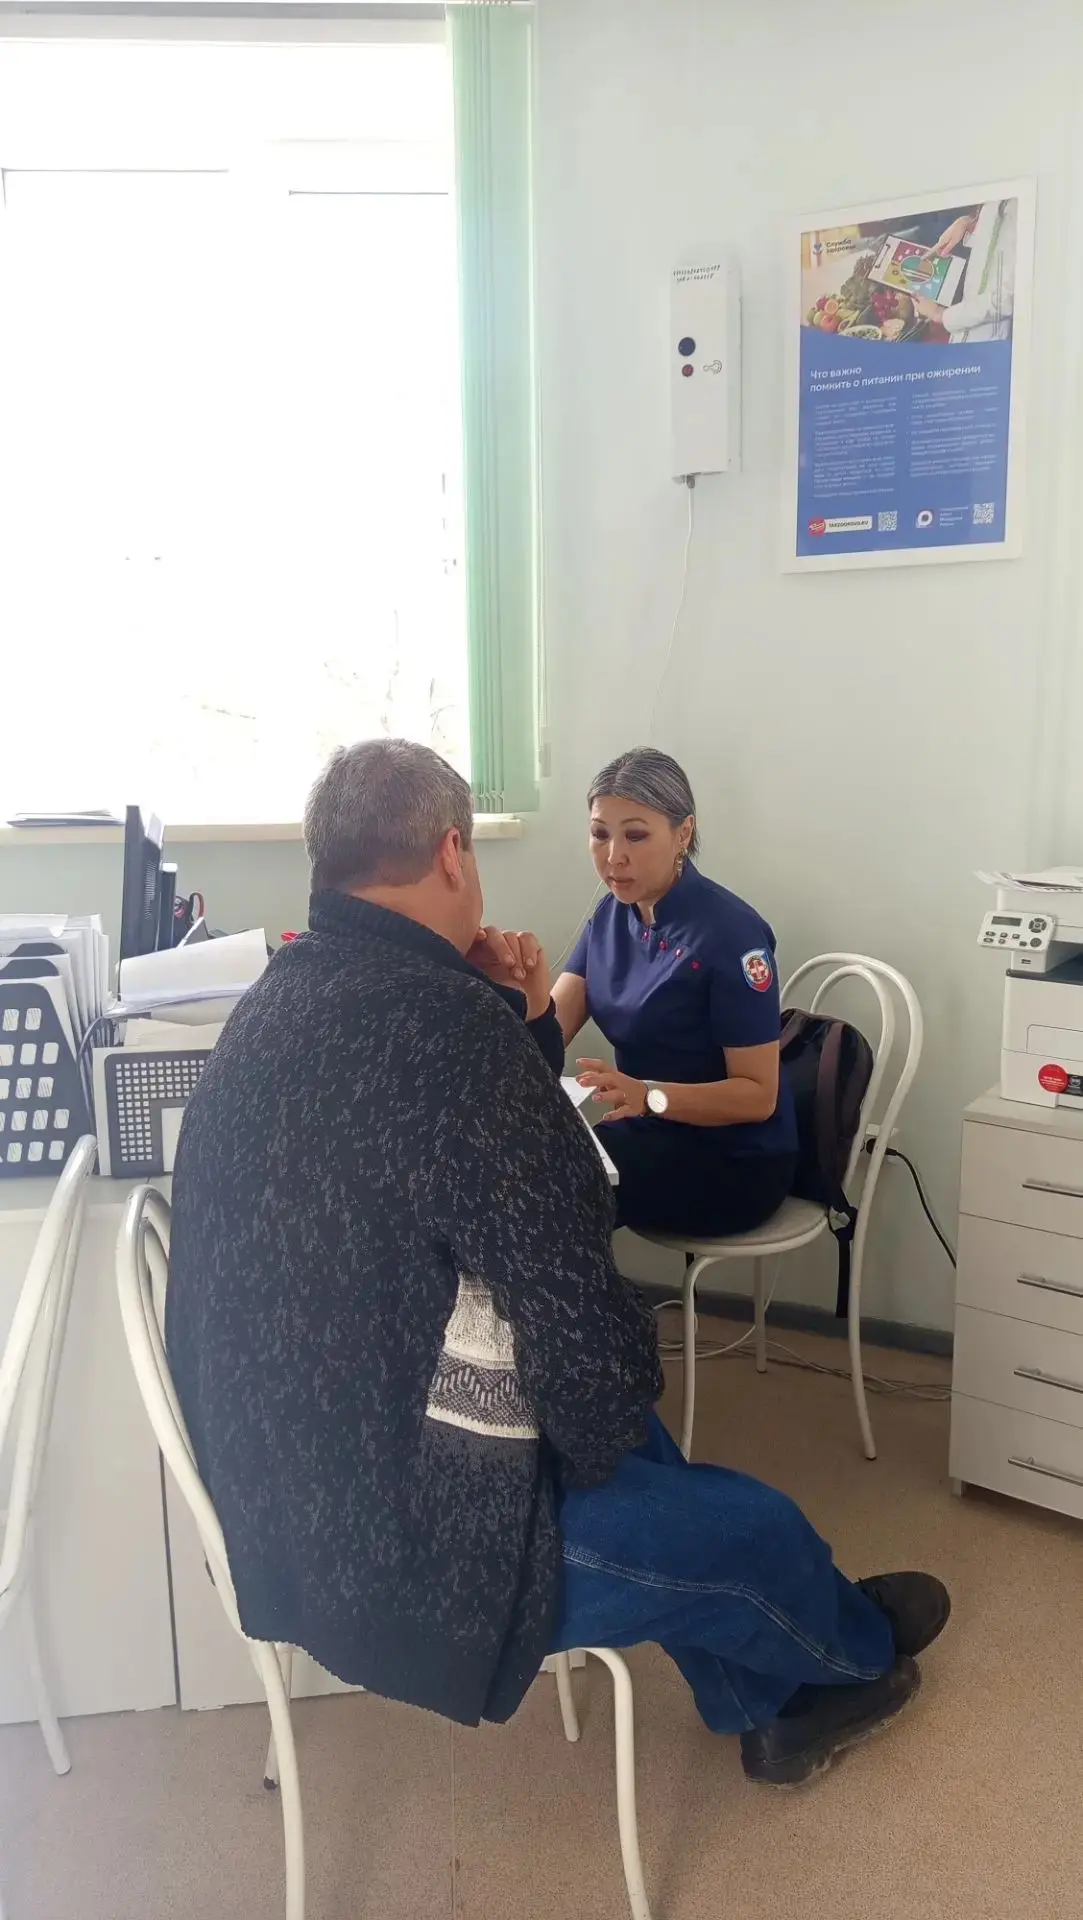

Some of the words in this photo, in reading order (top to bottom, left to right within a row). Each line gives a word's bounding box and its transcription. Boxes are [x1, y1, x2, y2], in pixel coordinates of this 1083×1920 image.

[810, 370, 828, 380] Что
[830, 366, 862, 377] важно
[810, 381, 851, 393] помнить
[852, 378, 859, 387] о
[861, 374, 903, 387] питании
[904, 371, 925, 383] при
[927, 365, 981, 380] ожирении
